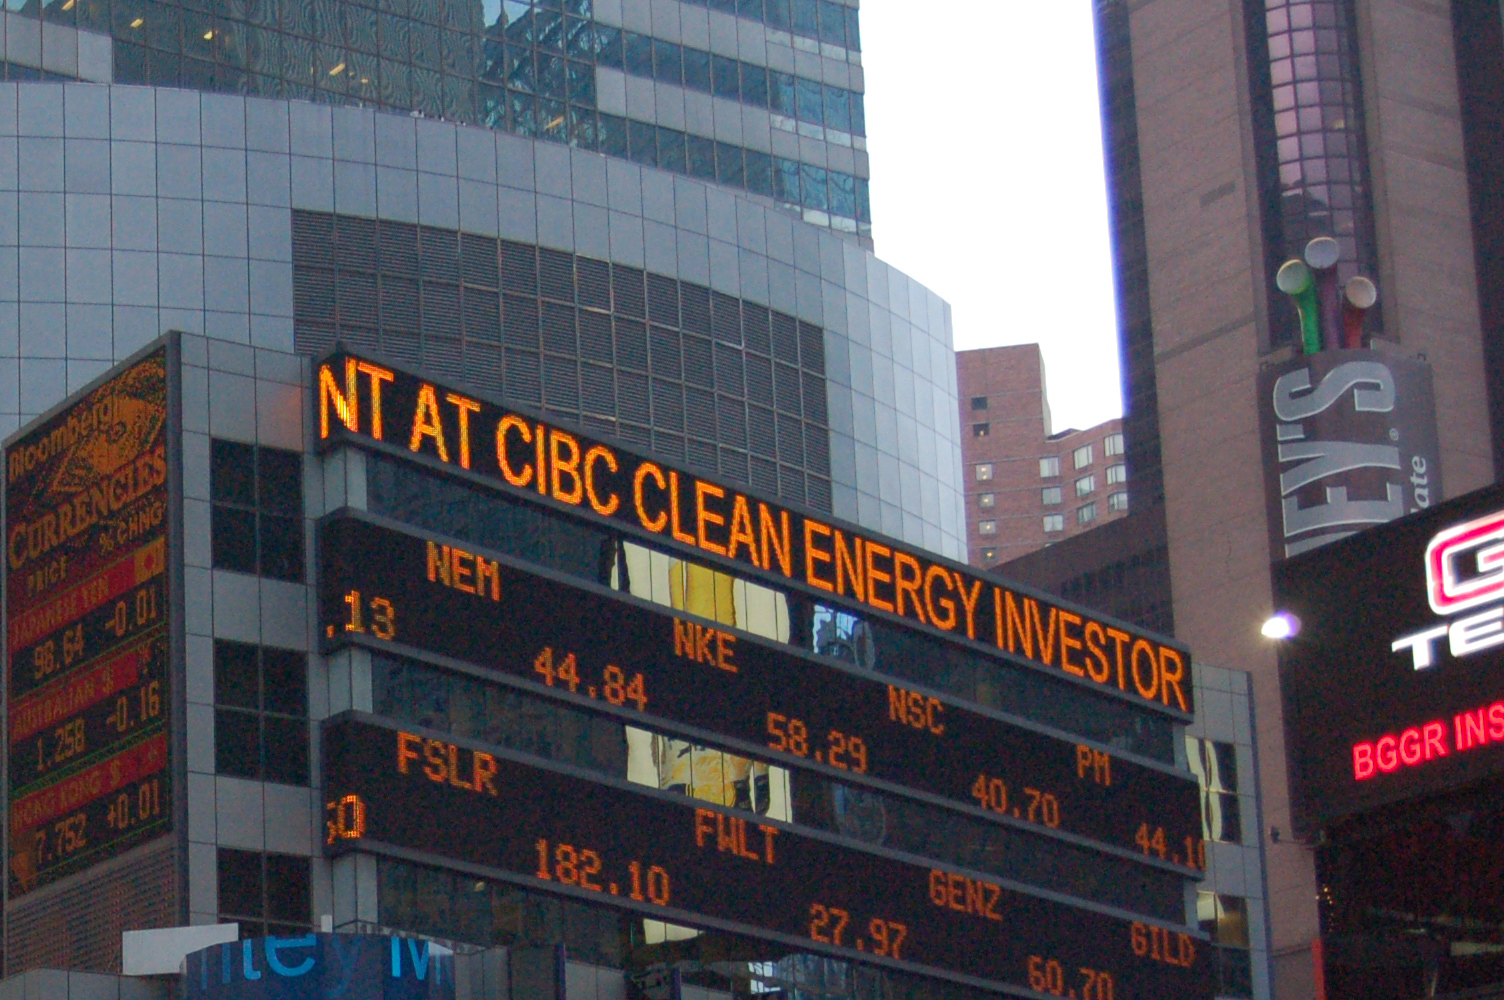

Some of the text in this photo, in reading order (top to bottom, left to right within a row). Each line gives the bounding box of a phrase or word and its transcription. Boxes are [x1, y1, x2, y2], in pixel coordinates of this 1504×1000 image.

[8, 443, 167, 570] CURRENCIES
[1409, 454, 1430, 514] ate
[319, 356, 1188, 713] NT AT CIBC CLEAN ENERGY INVESTOR
[104, 585, 157, 637] -0.01
[105, 680, 160, 732] -0.16
[426, 540, 501, 601] NEM
[534, 647, 648, 713] 44.84
[674, 616, 738, 673] NKE
[766, 711, 867, 774] 58.29
[889, 684, 946, 735] NSC
[971, 774, 1059, 829] 40.70
[1075, 745, 1111, 787] PM
[1352, 720, 1449, 781] BGGR
[106, 779, 160, 829] +0.01
[397, 731, 498, 796] FSLR
[535, 838, 670, 907] 182.10
[695, 807, 780, 864] FWLT
[809, 903, 907, 959] 27.97
[928, 869, 1003, 922] GENZ
[1130, 921, 1195, 968] GILD
